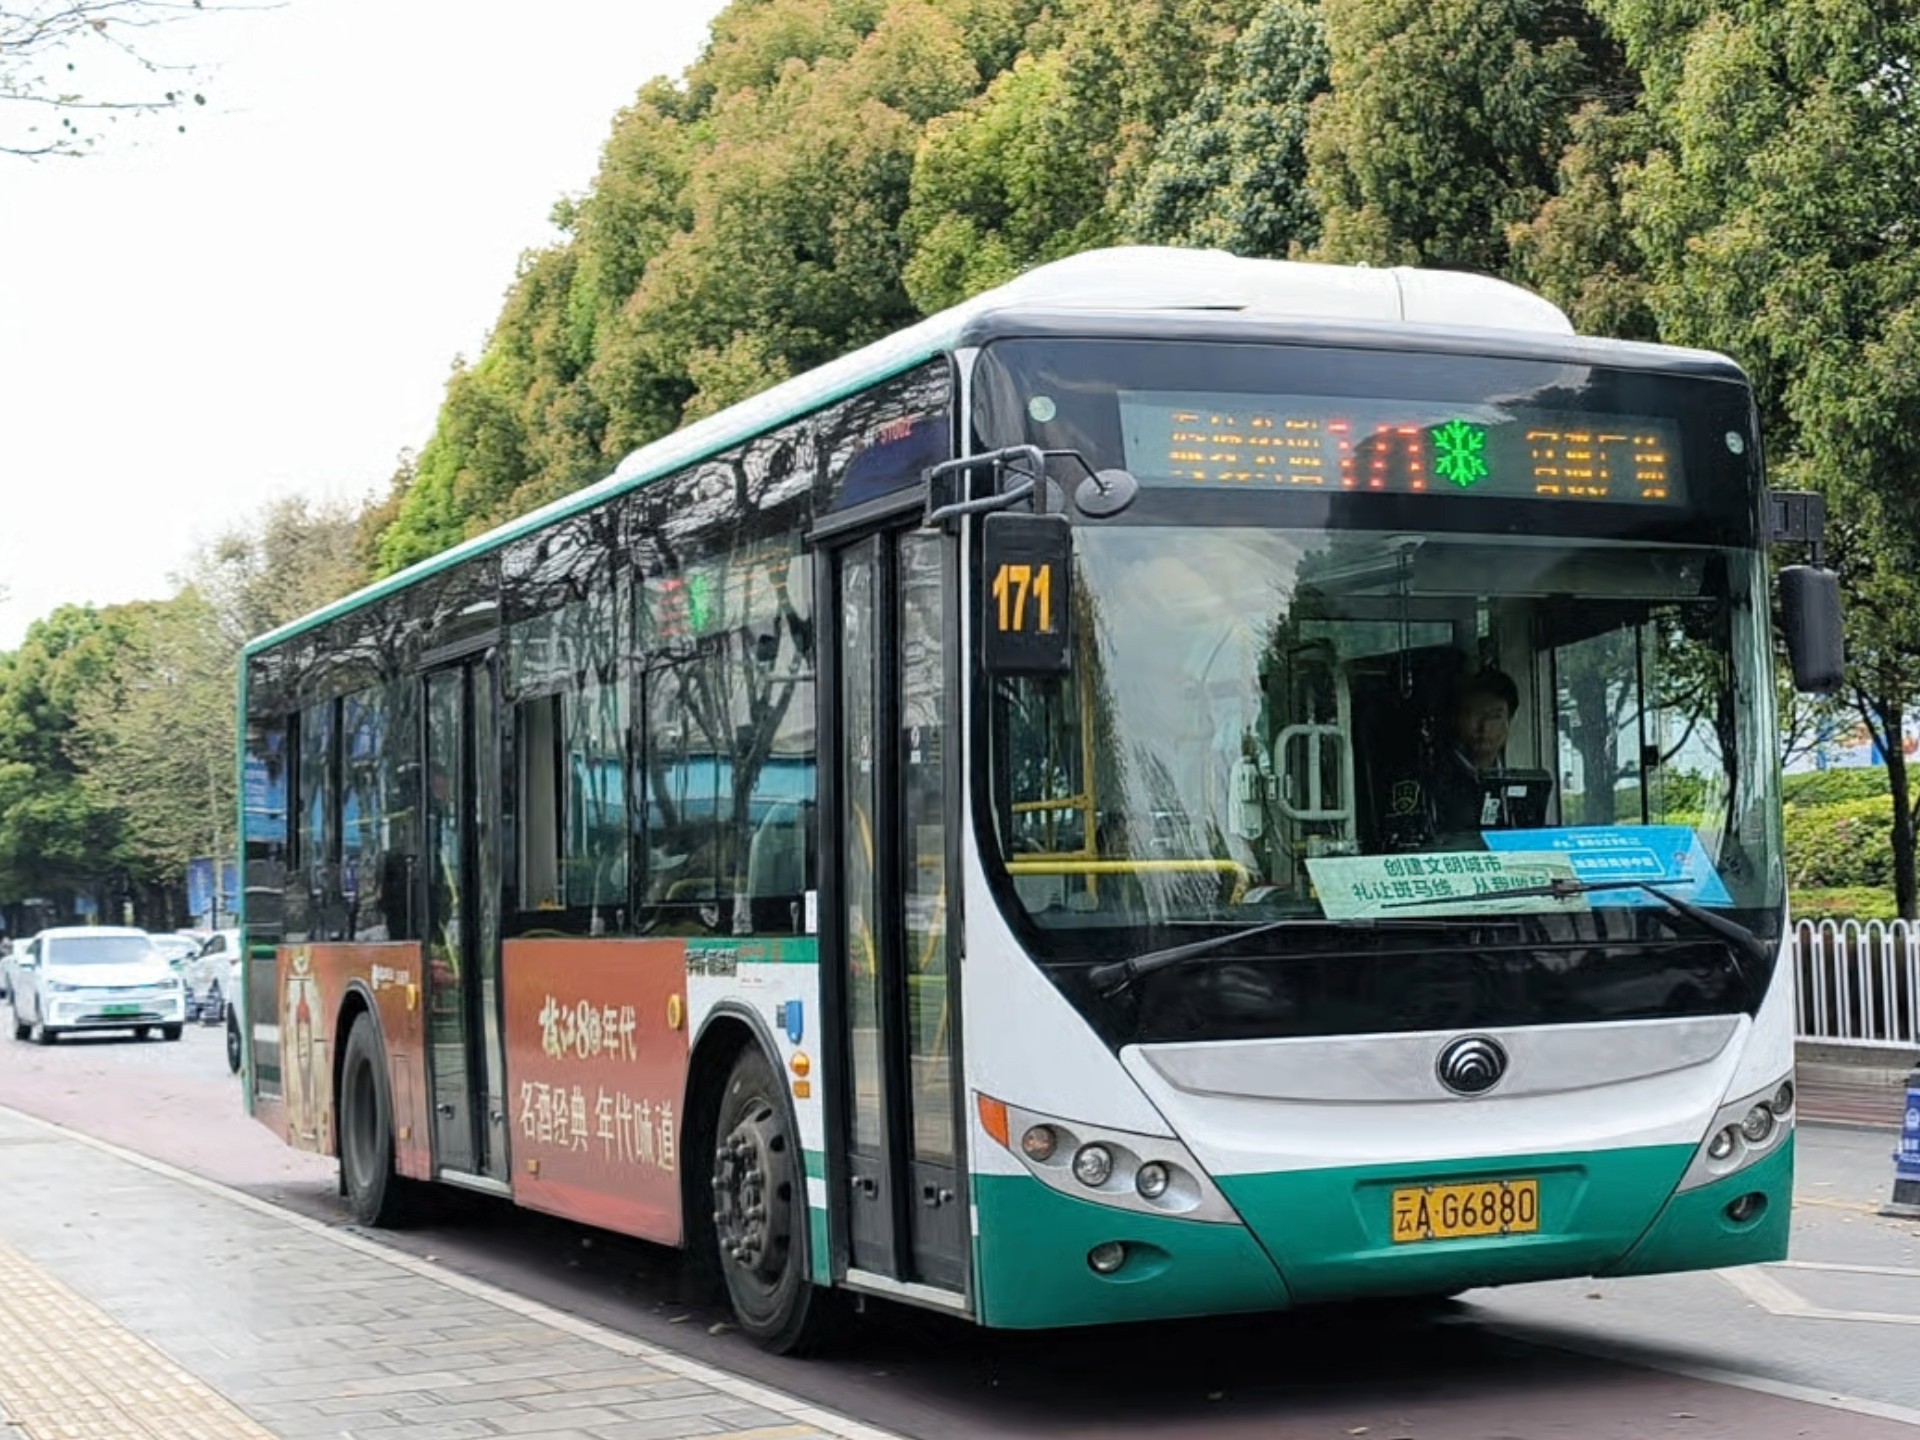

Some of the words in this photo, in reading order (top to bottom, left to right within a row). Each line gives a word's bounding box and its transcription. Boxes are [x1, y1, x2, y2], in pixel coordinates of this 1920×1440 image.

[992, 564, 1051, 631] 171
[1383, 856, 1502, 877] 创建文明城市
[520, 1080, 589, 1152] 名酒经典
[595, 1085, 675, 1172] 年代味道
